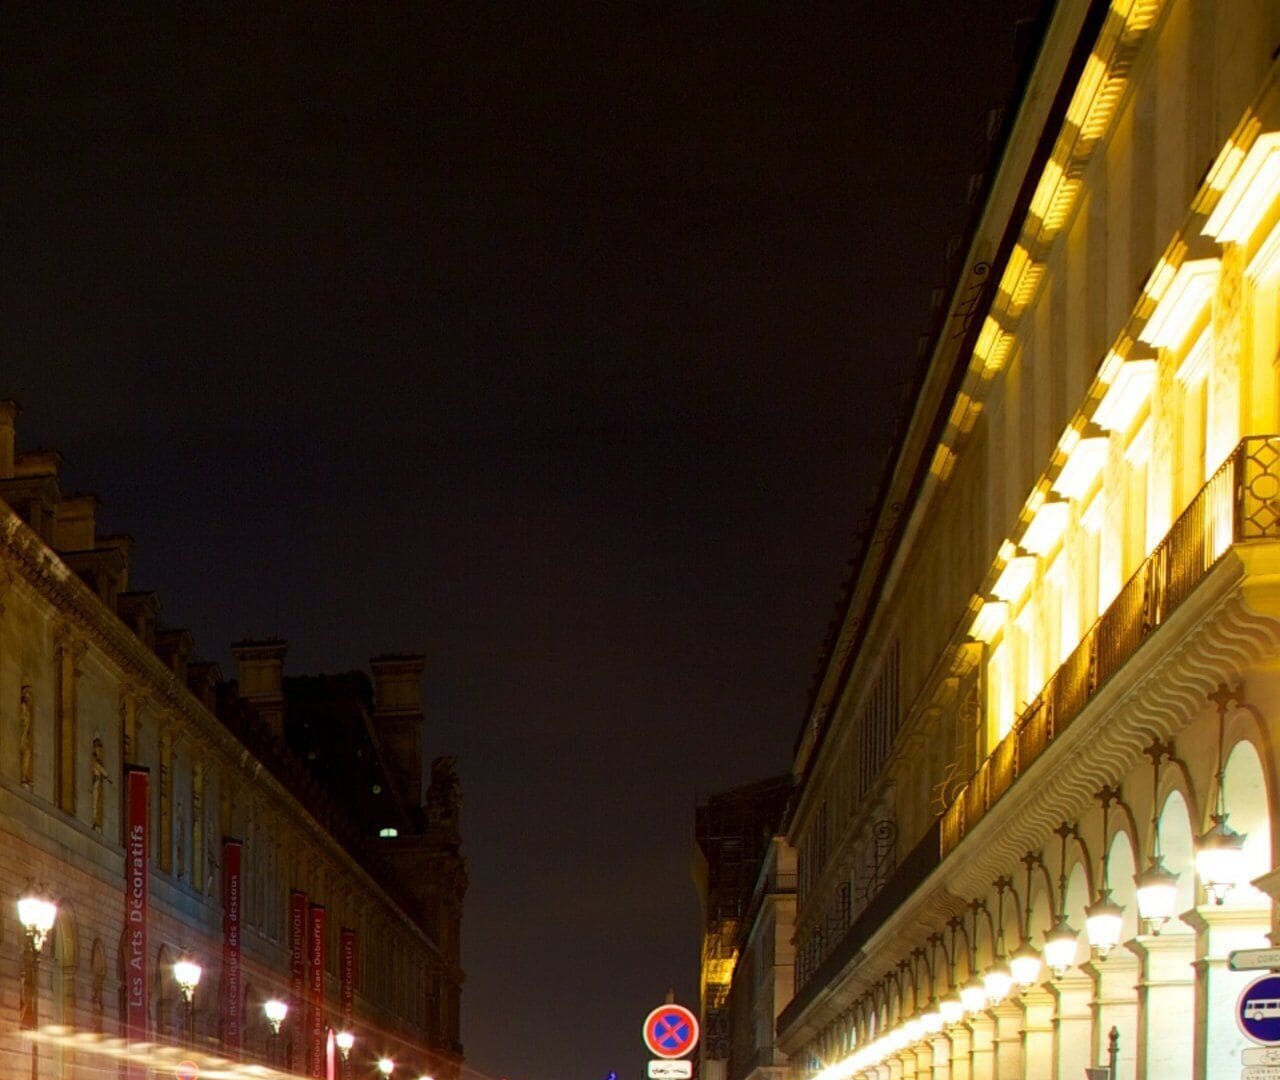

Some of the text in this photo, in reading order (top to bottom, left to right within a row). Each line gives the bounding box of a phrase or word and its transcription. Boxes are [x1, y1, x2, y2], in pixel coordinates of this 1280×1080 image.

[130, 825, 145, 1007] Les Arts Décoratifs
